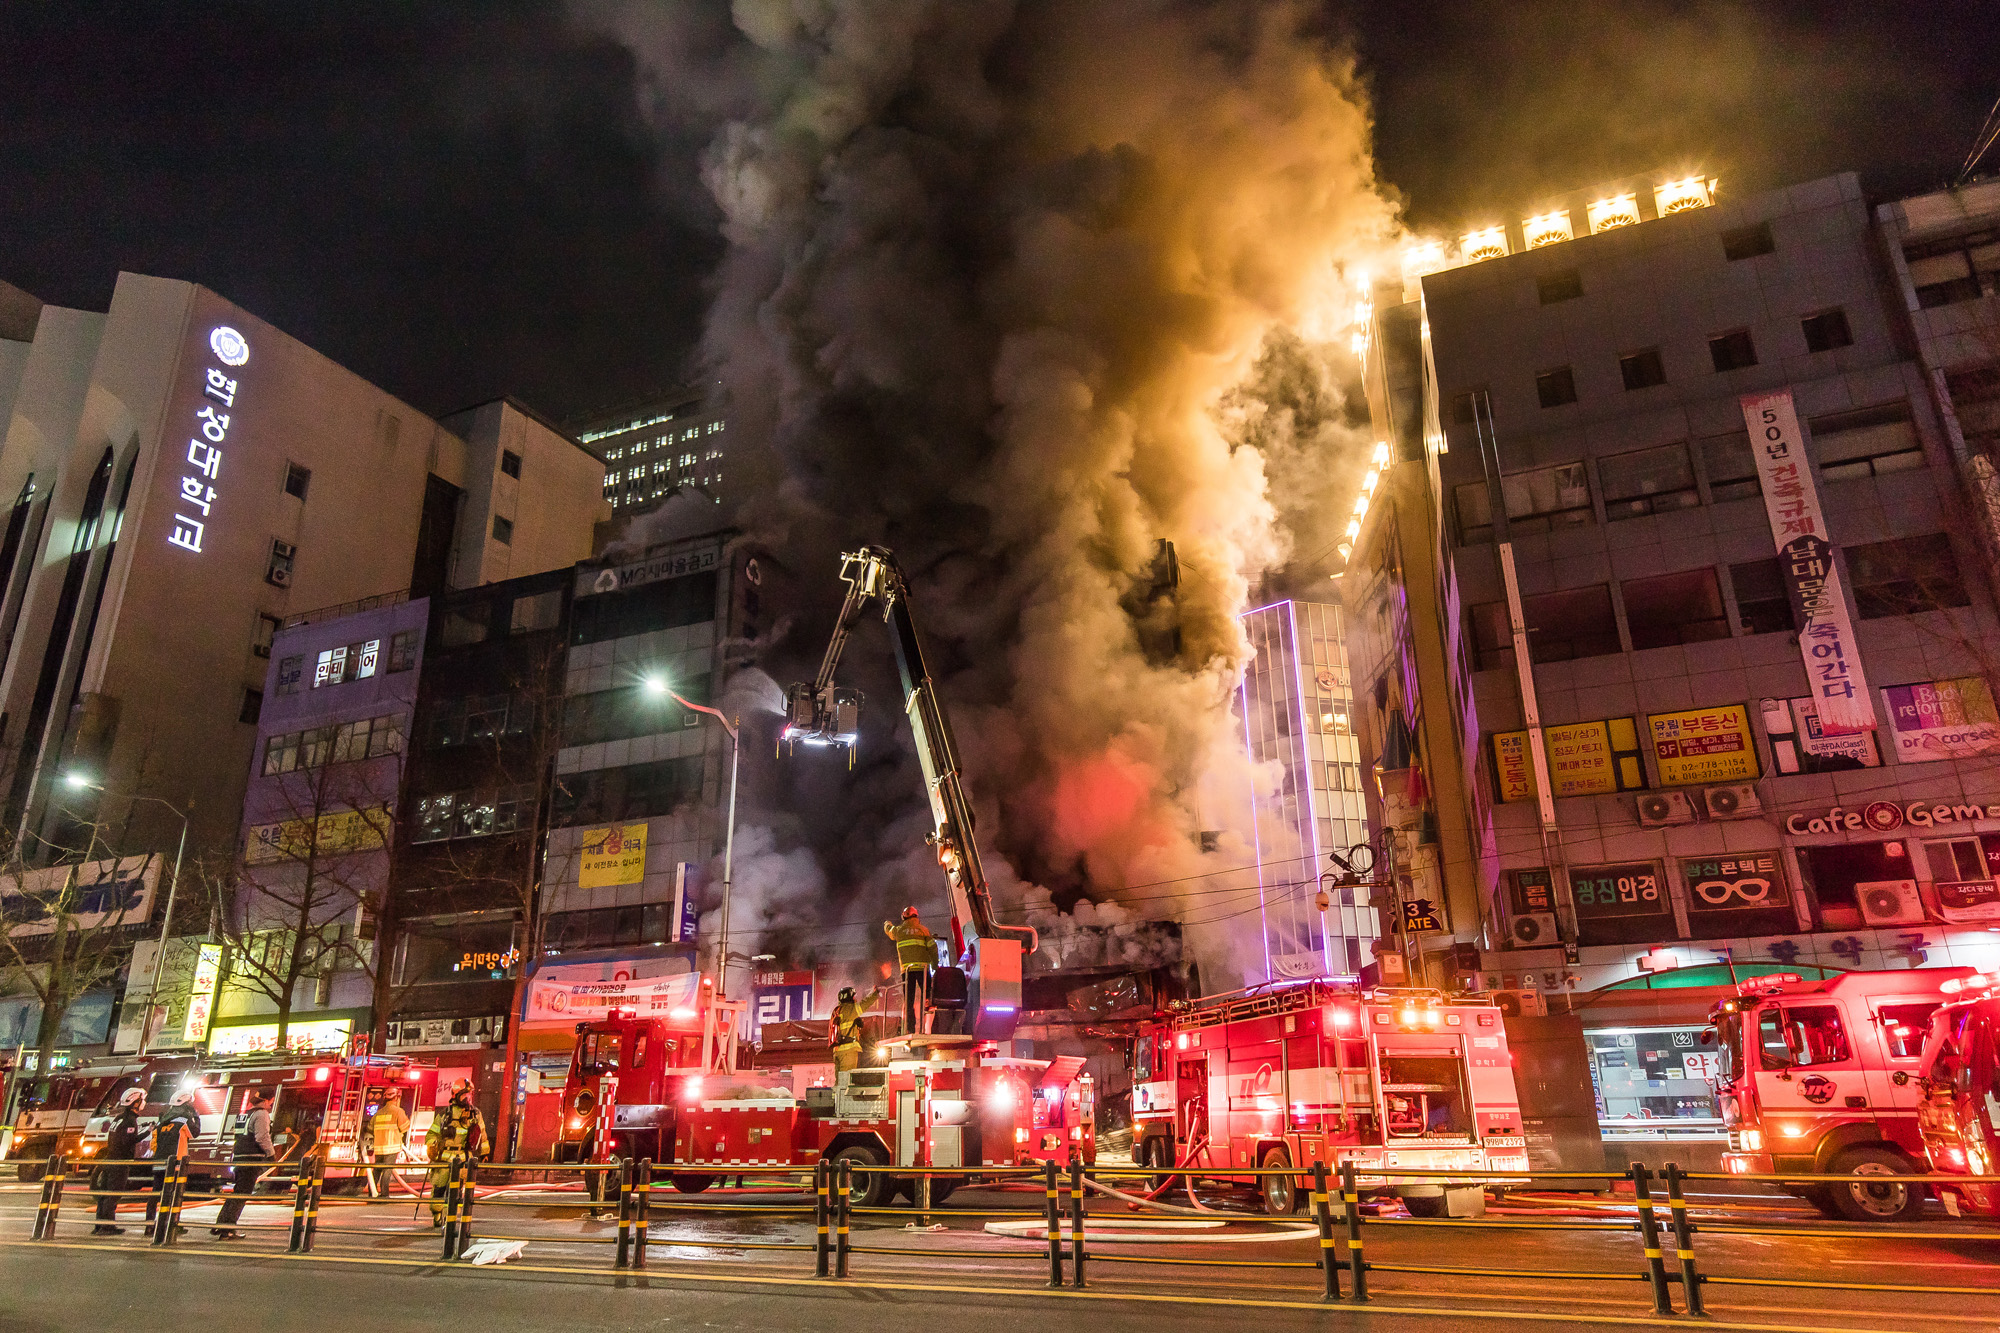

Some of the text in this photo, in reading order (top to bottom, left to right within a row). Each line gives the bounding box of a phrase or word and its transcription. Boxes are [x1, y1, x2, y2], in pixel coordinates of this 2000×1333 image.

[1761, 409, 1789, 459] 50년
[168, 368, 238, 554] 협성대학교
[1682, 712, 1739, 733] 부동산
[1660, 744, 1676, 756] 3F
[1503, 754, 1529, 797] 부동산
[1682, 758, 1745, 772] 02-778-1154
[1682, 767, 1747, 780] 010-3733-1154
[1786, 807, 1863, 835] Cafe
[1906, 801, 1985, 828] Gem
[1239, 1062, 1273, 1100] 119
[1806, 1081, 1837, 1099] 119
[1504, 1138, 1523, 1146] 2392
